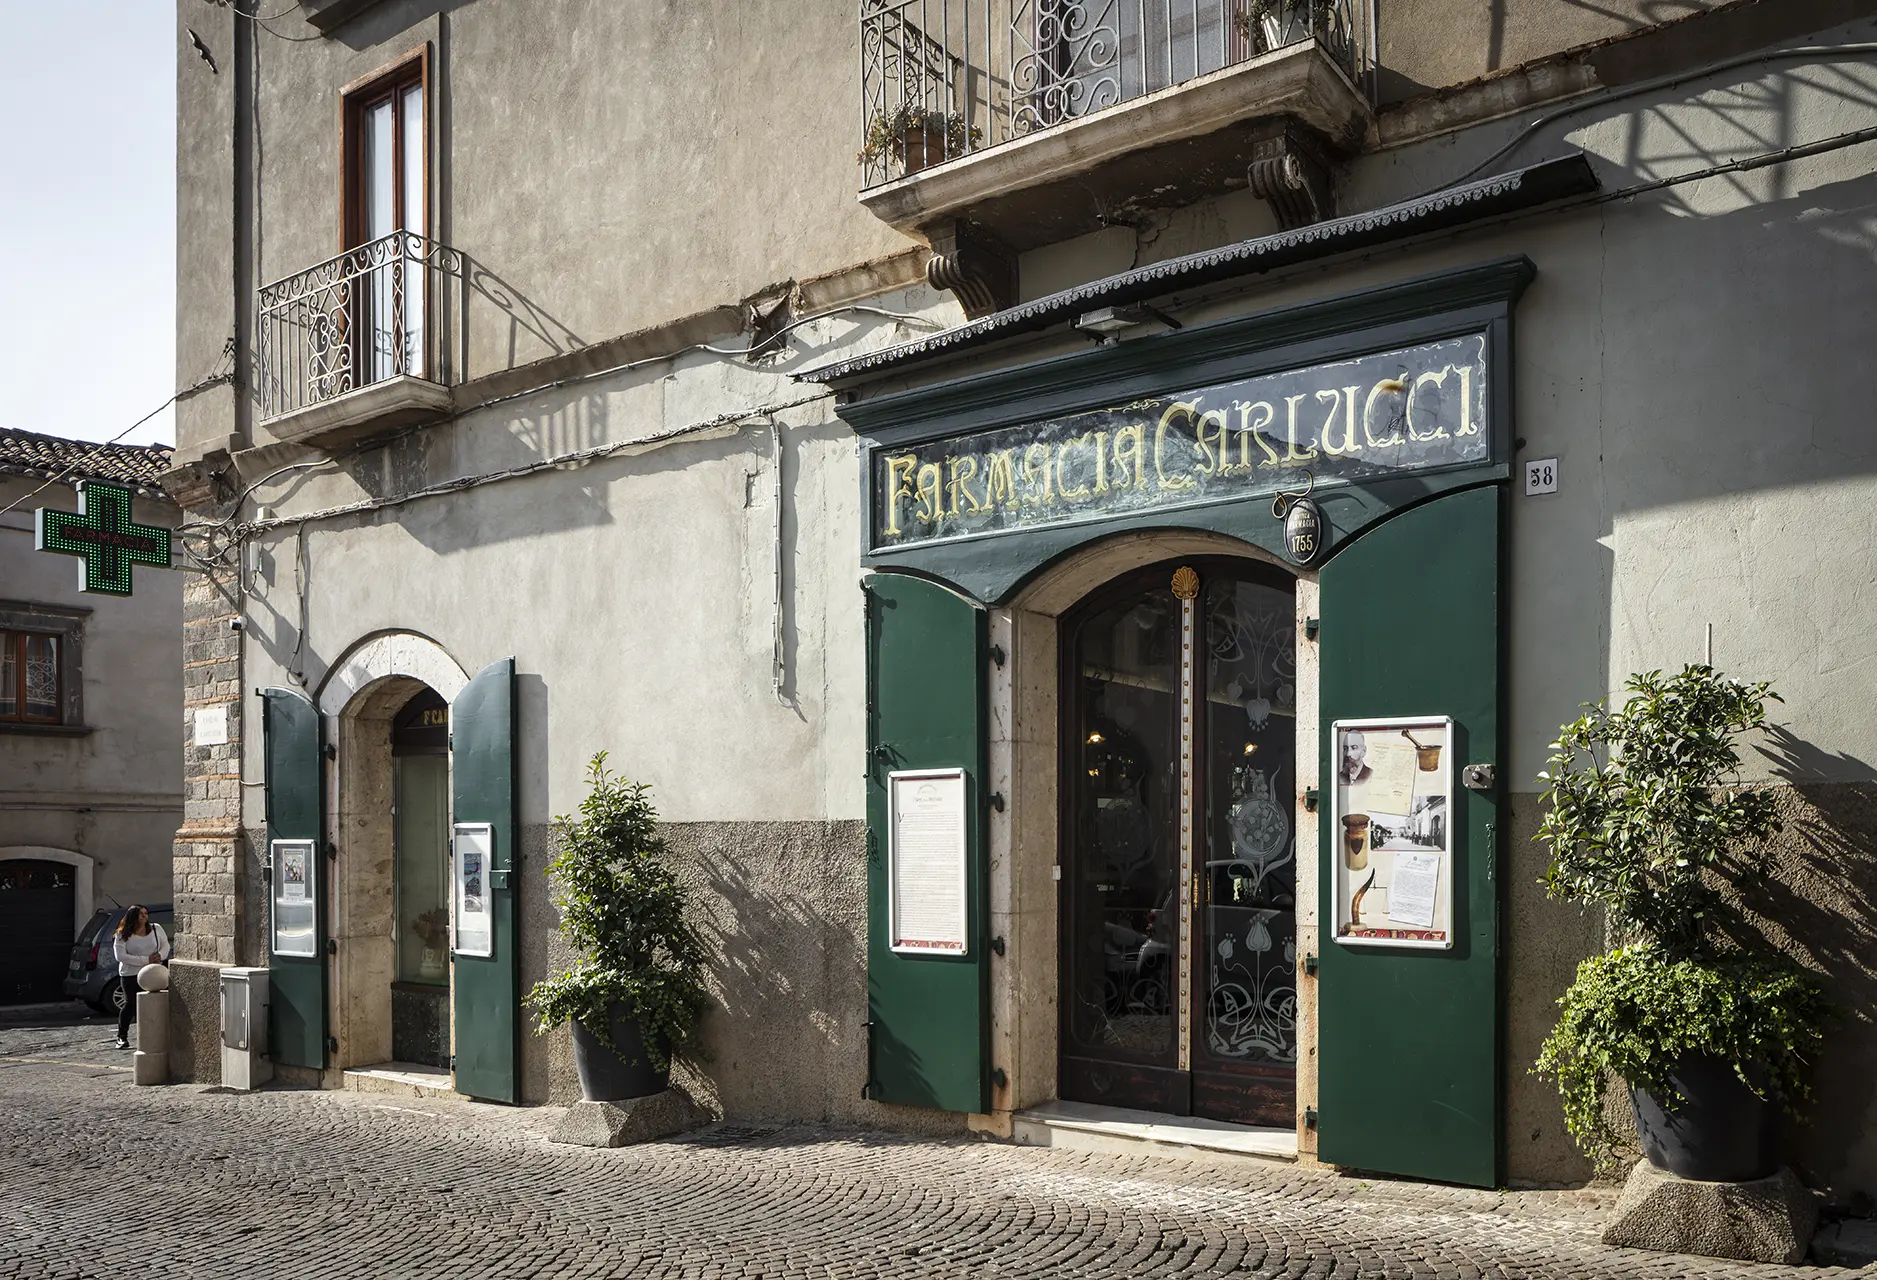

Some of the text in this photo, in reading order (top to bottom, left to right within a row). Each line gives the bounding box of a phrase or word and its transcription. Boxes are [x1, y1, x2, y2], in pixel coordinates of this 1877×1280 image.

[1530, 465, 1553, 487] 58
[64, 526, 152, 549] FARMACIA
[1291, 534, 1313, 553] 1755
